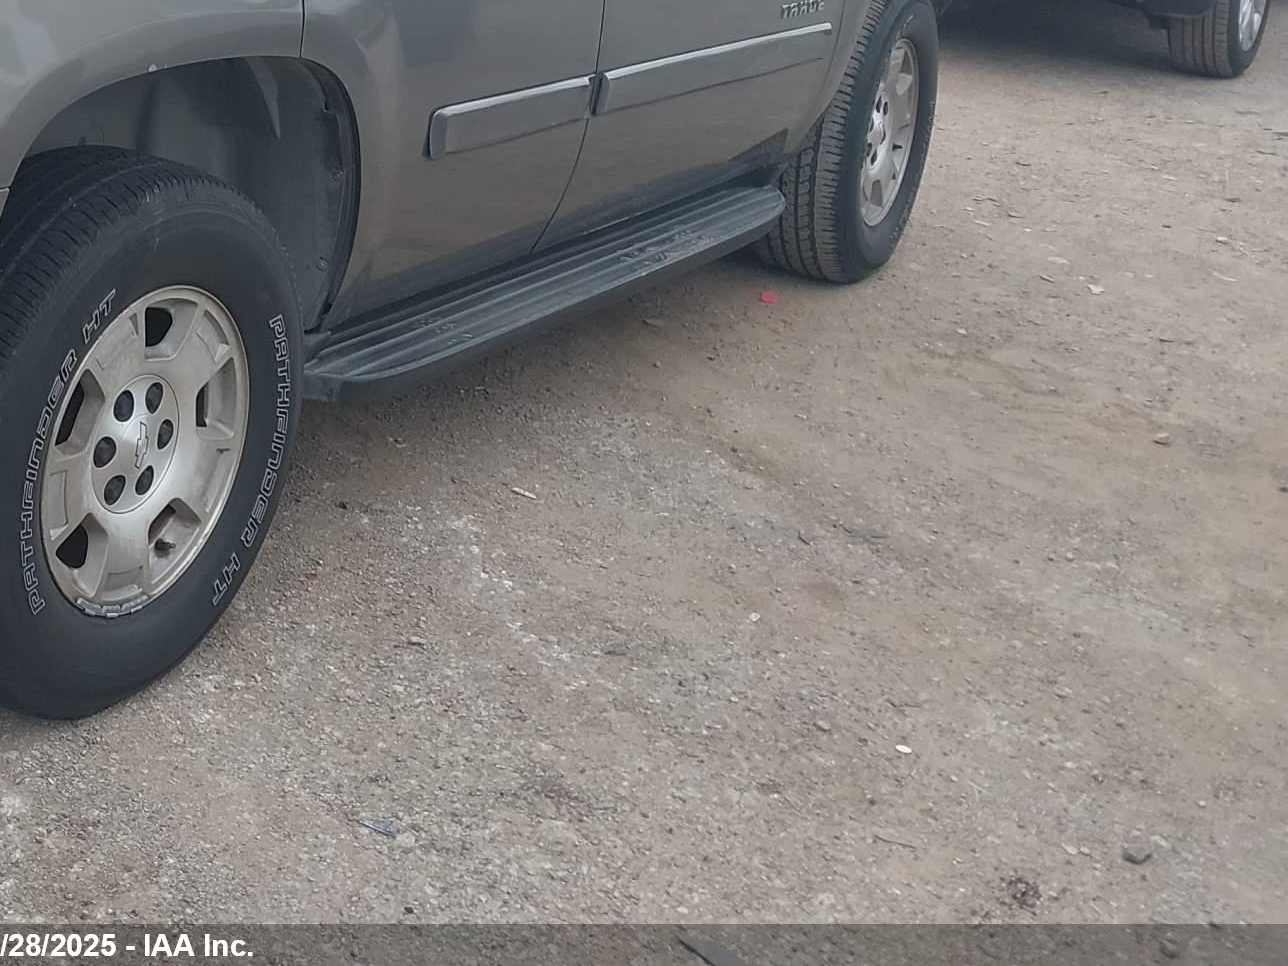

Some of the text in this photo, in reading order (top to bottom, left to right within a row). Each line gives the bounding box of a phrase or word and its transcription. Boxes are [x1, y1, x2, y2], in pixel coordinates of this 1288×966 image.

[20, 288, 116, 616] PATHFINDER HT
[212, 314, 290, 606] PATHFINDER HT
